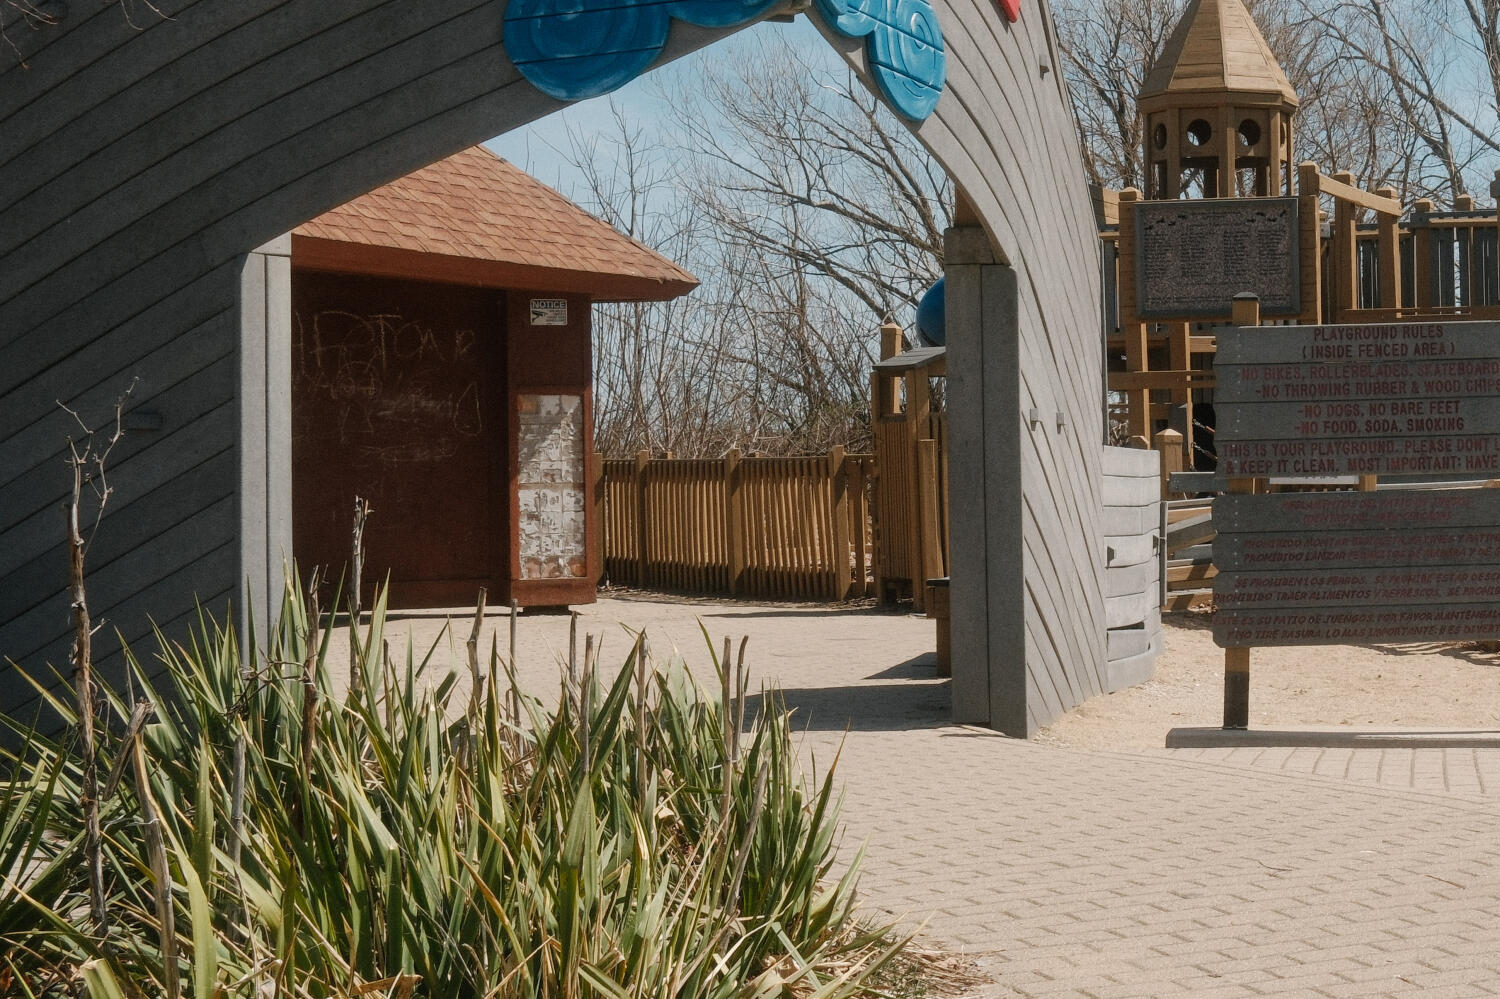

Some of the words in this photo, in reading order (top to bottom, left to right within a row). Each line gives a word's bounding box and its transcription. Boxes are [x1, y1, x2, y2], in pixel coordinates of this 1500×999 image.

[531, 300, 566, 309] NOTICE
[1314, 326, 1397, 341] PLAYGROUND
[1402, 325, 1444, 339] RULES
[1358, 343, 1408, 357] FENCED
[1241, 367, 1258, 381] NO
[1263, 366, 1306, 381] BIKES,
[1285, 382, 1350, 397] THROWING
[1355, 381, 1406, 396] RUBBER
[1411, 380, 1419, 393] &
[1424, 380, 1461, 394] WOOD
[1369, 403, 1386, 416] NO
[1391, 402, 1425, 415] BARE
[1429, 400, 1461, 414] FEET
[1407, 417, 1465, 432] SMOKING
[1223, 443, 1250, 457] THIS
[1255, 442, 1266, 457] IS
[1271, 442, 1305, 457] YOUR
[1404, 437, 1453, 453] PLEASE
[1457, 437, 1488, 452] DONT
[1225, 460, 1234, 474] &
[1240, 459, 1273, 474] KEEP
[1277, 459, 1289, 473] IT
[1293, 458, 1340, 473] CLEAN.
[1347, 457, 1381, 472] MOST
[1386, 455, 1461, 471] IMPORTANT:
[1465, 454, 1499, 469] HAVE
[1243, 552, 1304, 564] PROHIBIDO
[1234, 578, 1248, 588] SE
[1213, 591, 1273, 603] PROHIBIDO
[1276, 590, 1308, 601] TRAER
[1308, 588, 1372, 600] ALIMENTOS
[1447, 586, 1462, 597] SE
[1257, 614, 1272, 625] SU
[1273, 614, 1307, 625] PATIO
[1308, 614, 1322, 625] DE
[1399, 610, 1433, 622] FAVOR
[1235, 629, 1253, 640] NO
[1255, 628, 1280, 640] TIRE
[1325, 627, 1341, 639] LO
[1341, 627, 1367, 638] MAS
